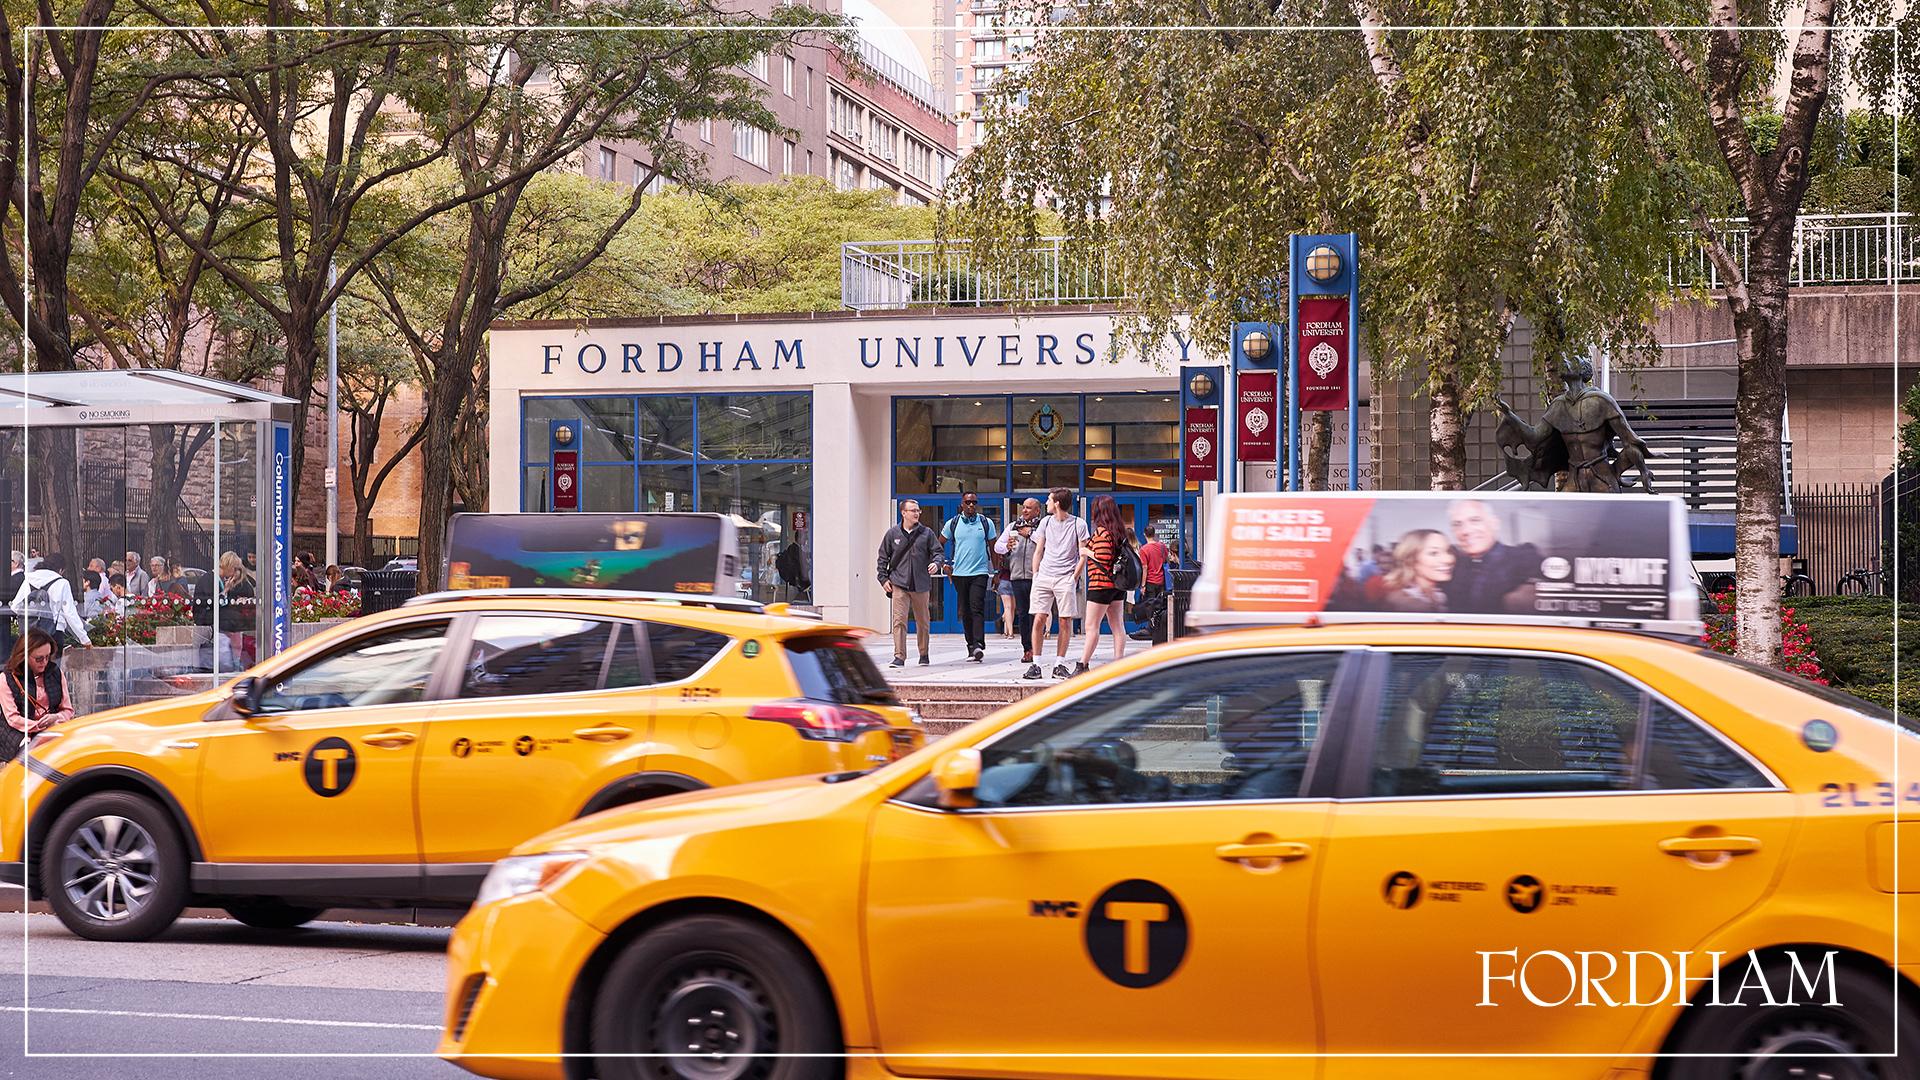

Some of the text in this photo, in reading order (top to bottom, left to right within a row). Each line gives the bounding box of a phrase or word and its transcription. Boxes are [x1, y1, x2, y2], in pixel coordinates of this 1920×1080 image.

[541, 340, 805, 374] FORDHAM
[100, 410, 131, 418] SMOKING
[275, 452, 284, 537] Columbus
[1231, 525, 1332, 542] ON SALE!
[1232, 508, 1325, 525] TICKETS
[275, 540, 284, 602] Avenue
[275, 606, 284, 619] &
[313, 748, 348, 790] T
[1030, 900, 1169, 975] NYC T
